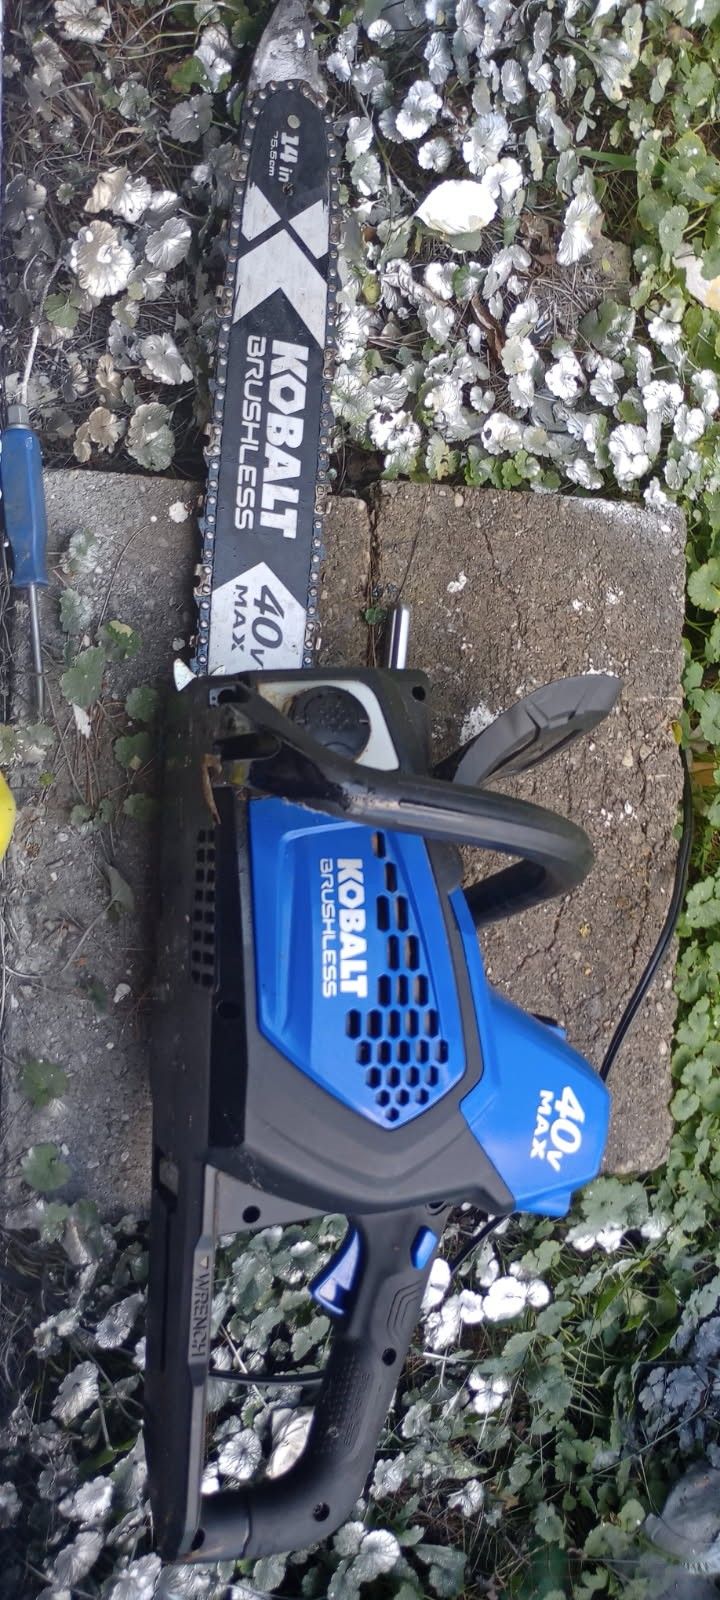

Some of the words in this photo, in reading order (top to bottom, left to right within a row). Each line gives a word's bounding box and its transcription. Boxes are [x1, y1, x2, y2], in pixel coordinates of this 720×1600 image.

[278, 166, 293, 182] in
[280, 132, 299, 163] 14
[234, 335, 266, 530] BRUSHLESS
[259, 339, 309, 539] KOBALT
[231, 584, 248, 652] MAX
[319, 857, 338, 998] BRUSHLESS
[336, 858, 368, 998] KOBALT
[529, 1089, 554, 1160] MAX
[191, 1272, 210, 1357] WRENCH
